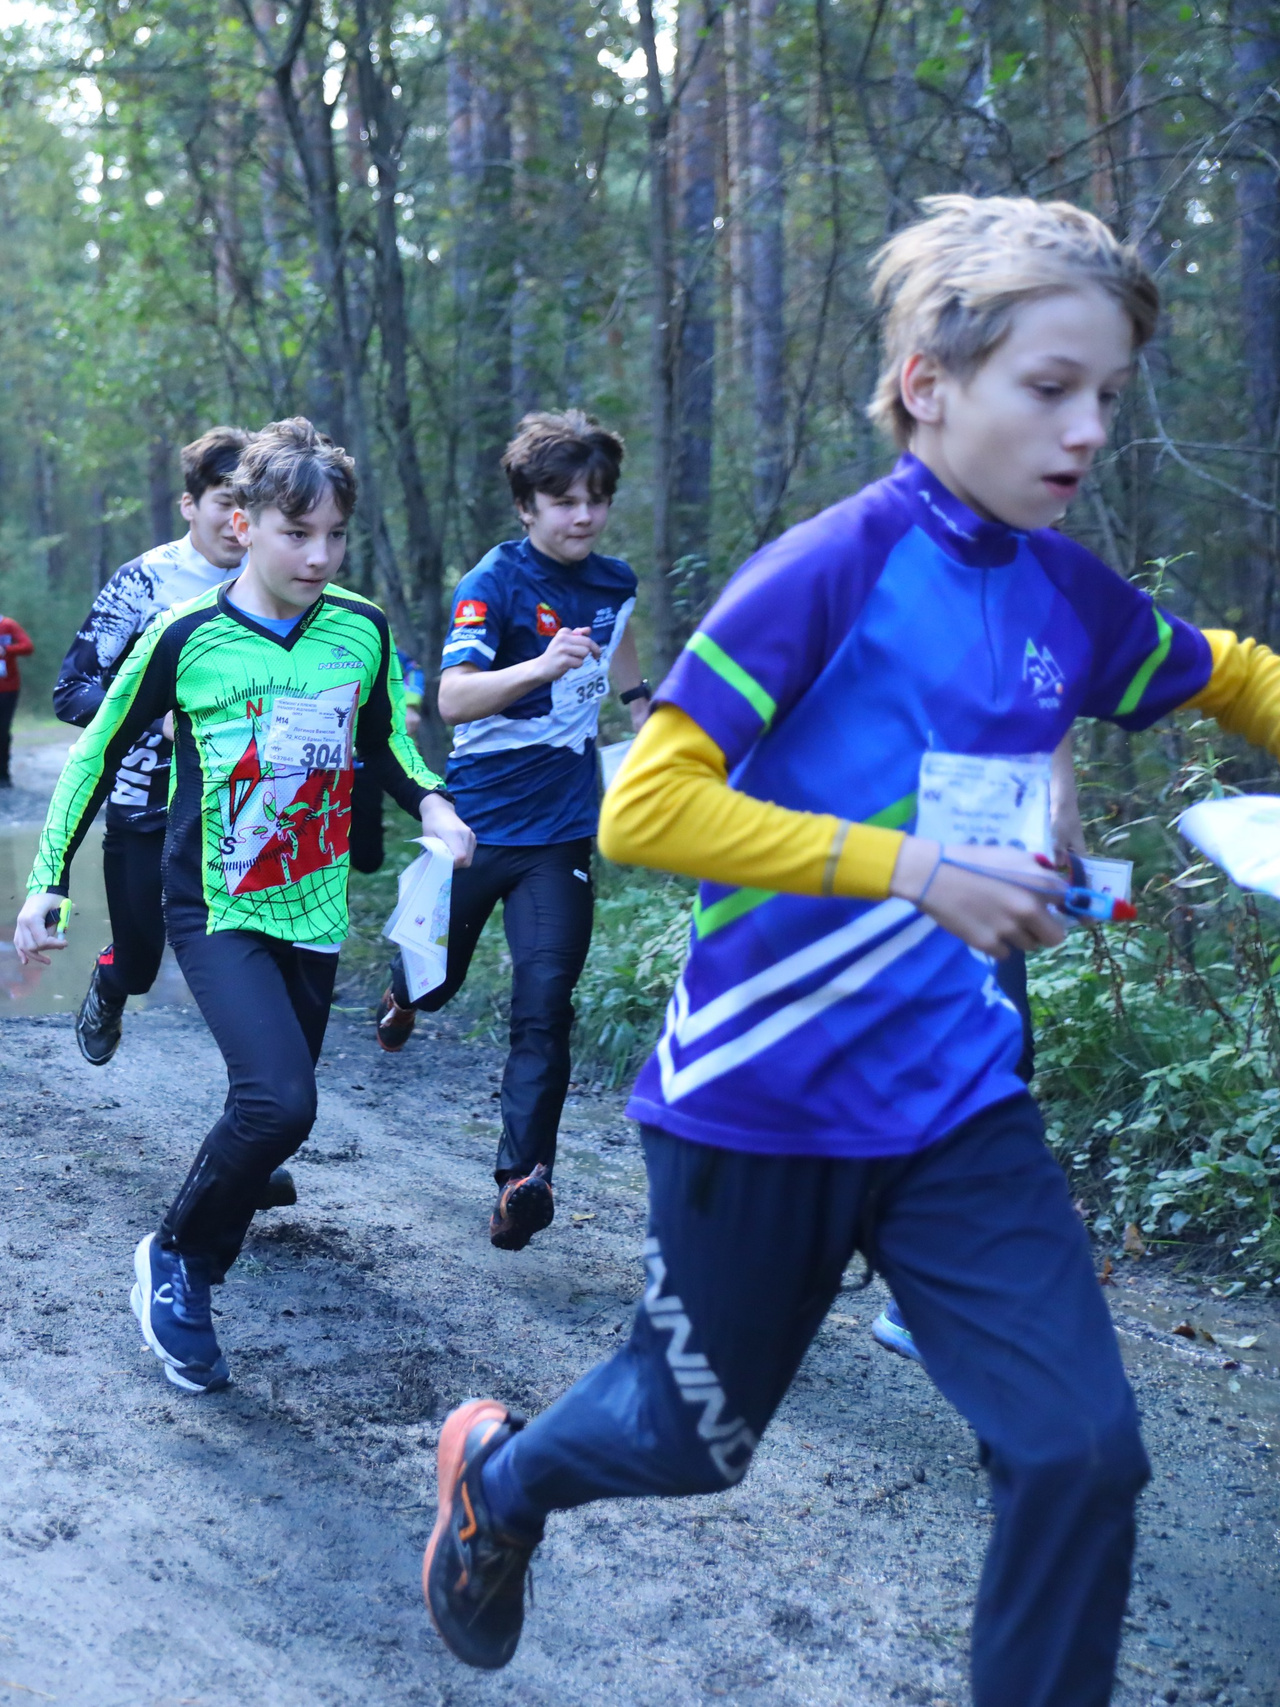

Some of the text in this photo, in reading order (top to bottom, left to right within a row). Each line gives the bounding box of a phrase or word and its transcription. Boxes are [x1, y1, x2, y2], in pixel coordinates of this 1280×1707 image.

[318, 661, 364, 670] NORD
[576, 676, 607, 704] 326
[246, 698, 263, 719] N
[299, 743, 343, 769] 304
[221, 836, 237, 855] S
